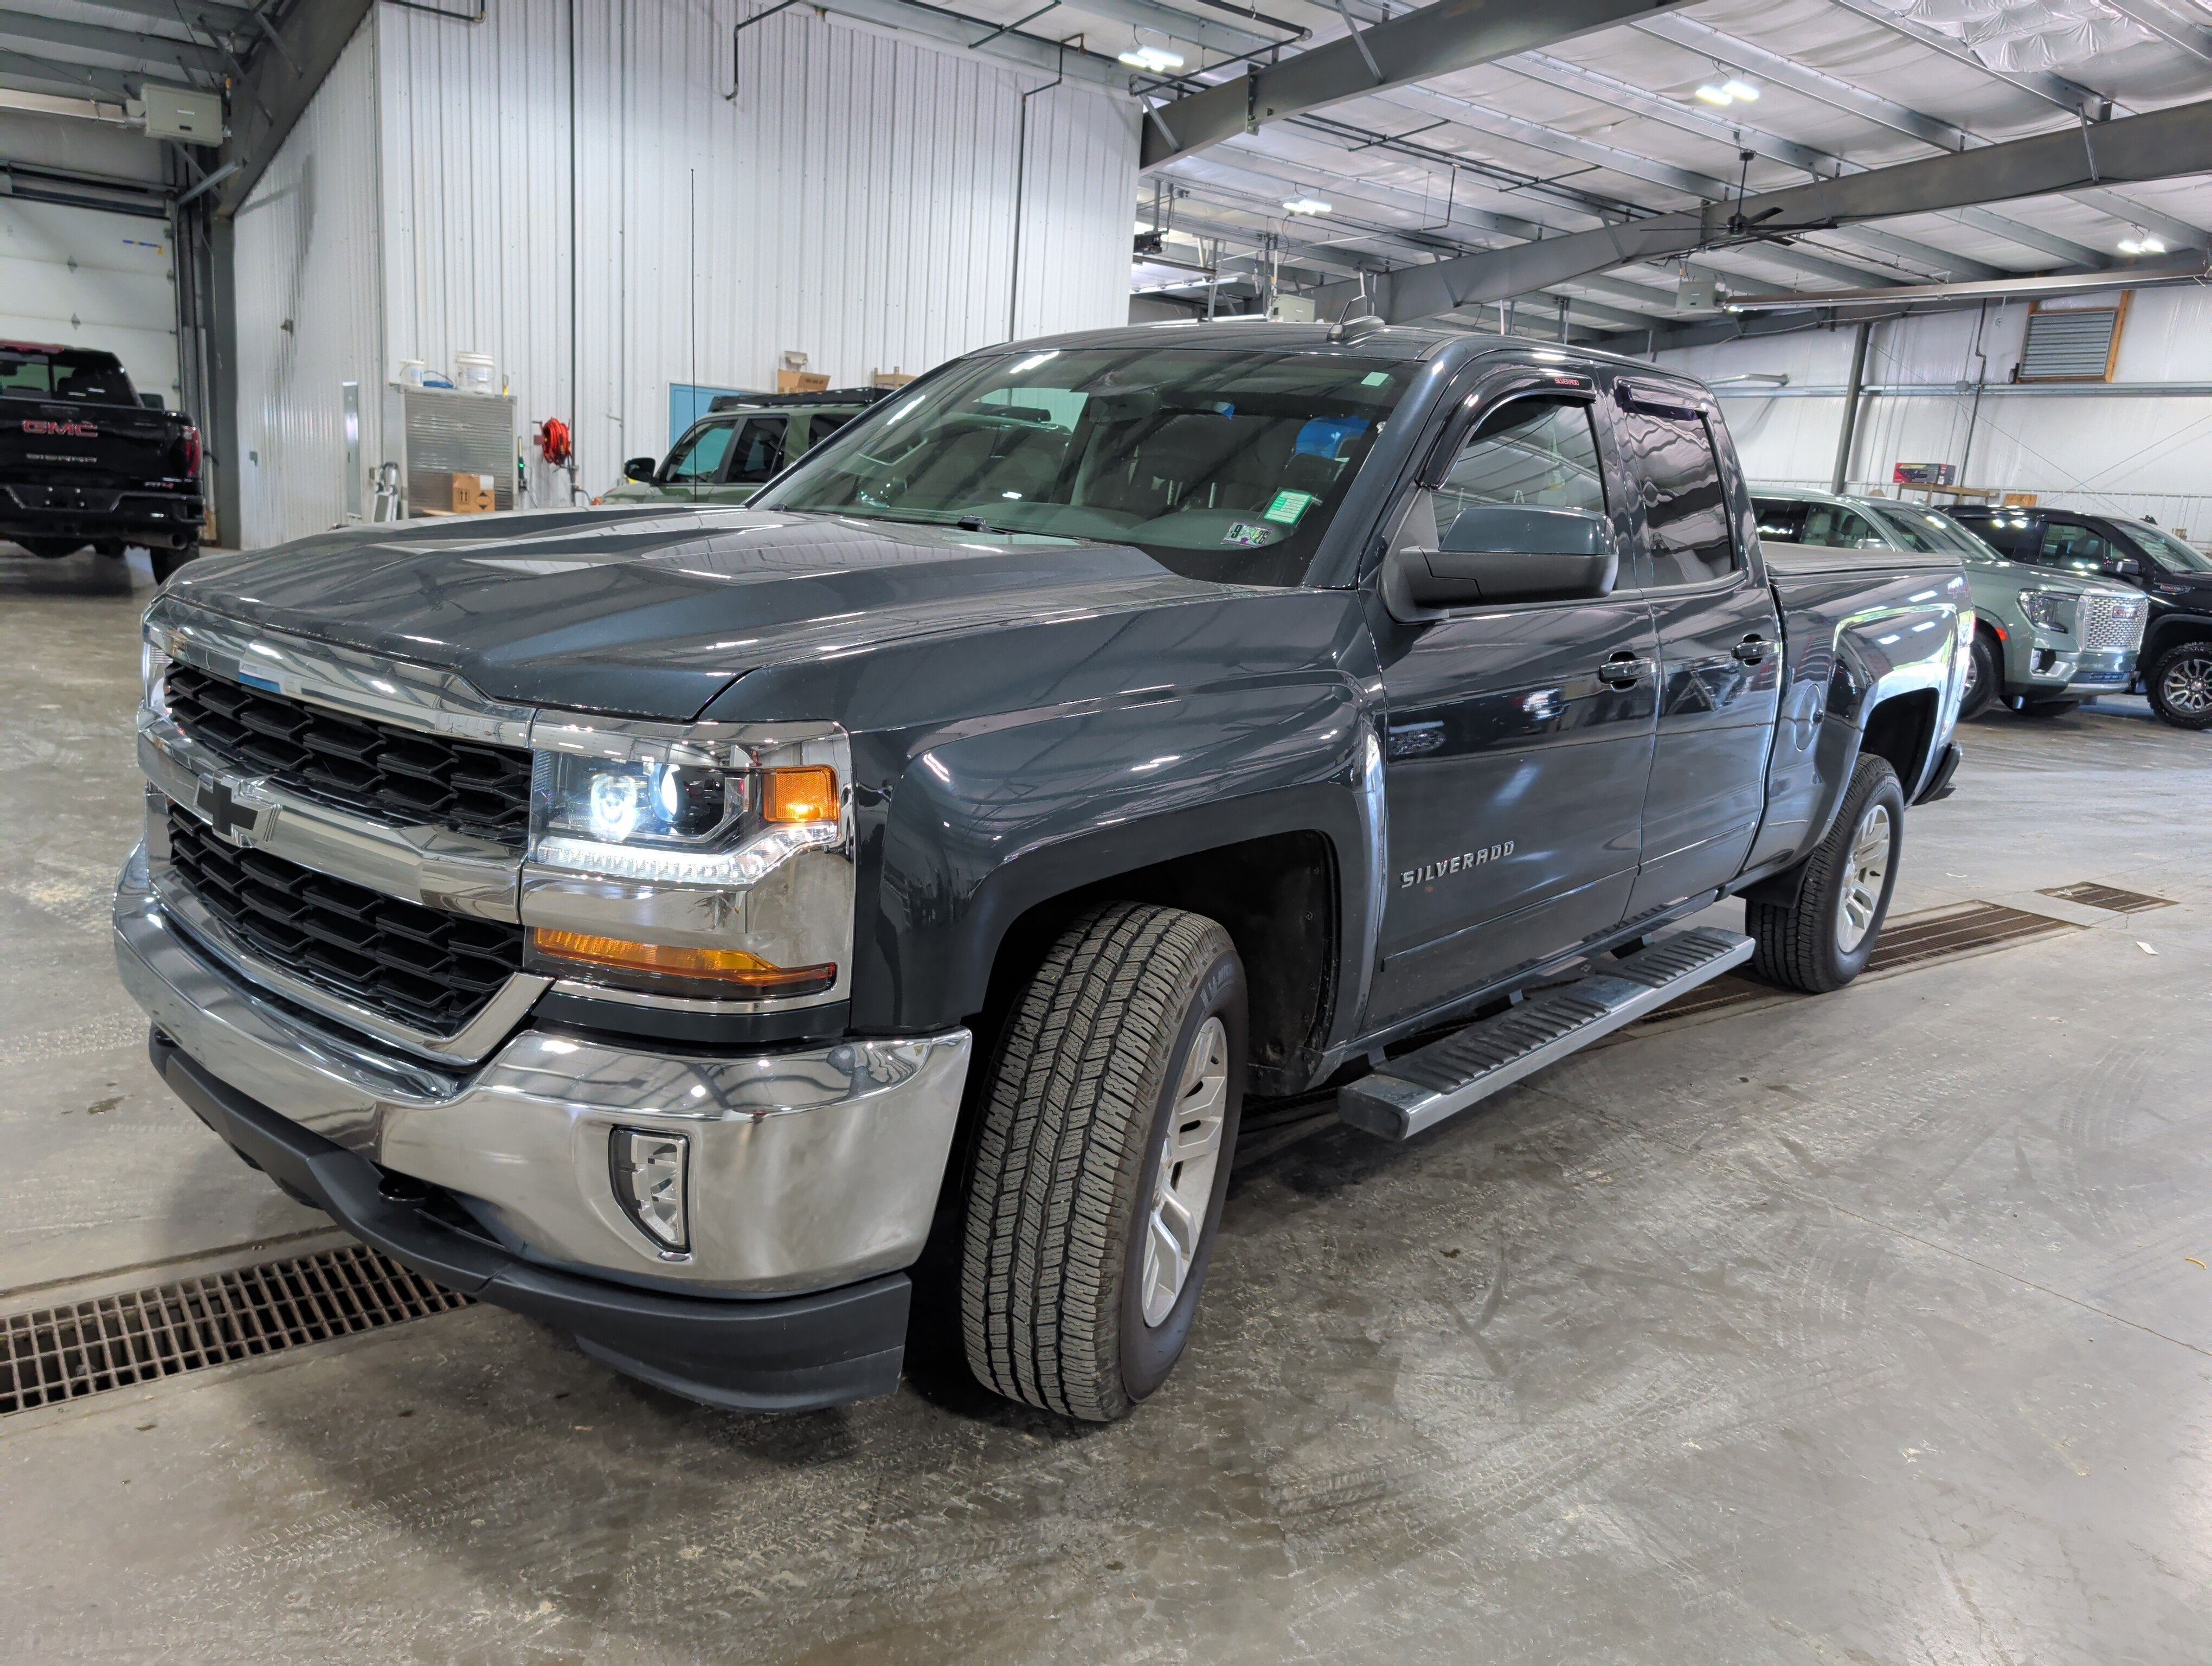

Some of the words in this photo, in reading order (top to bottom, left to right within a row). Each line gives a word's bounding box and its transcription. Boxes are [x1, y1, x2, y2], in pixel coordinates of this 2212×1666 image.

[22, 420, 98, 438] GMC
[1231, 524, 1243, 539] 9
[1253, 530, 1269, 544] 26
[1400, 840, 1515, 888] SILVERADO
